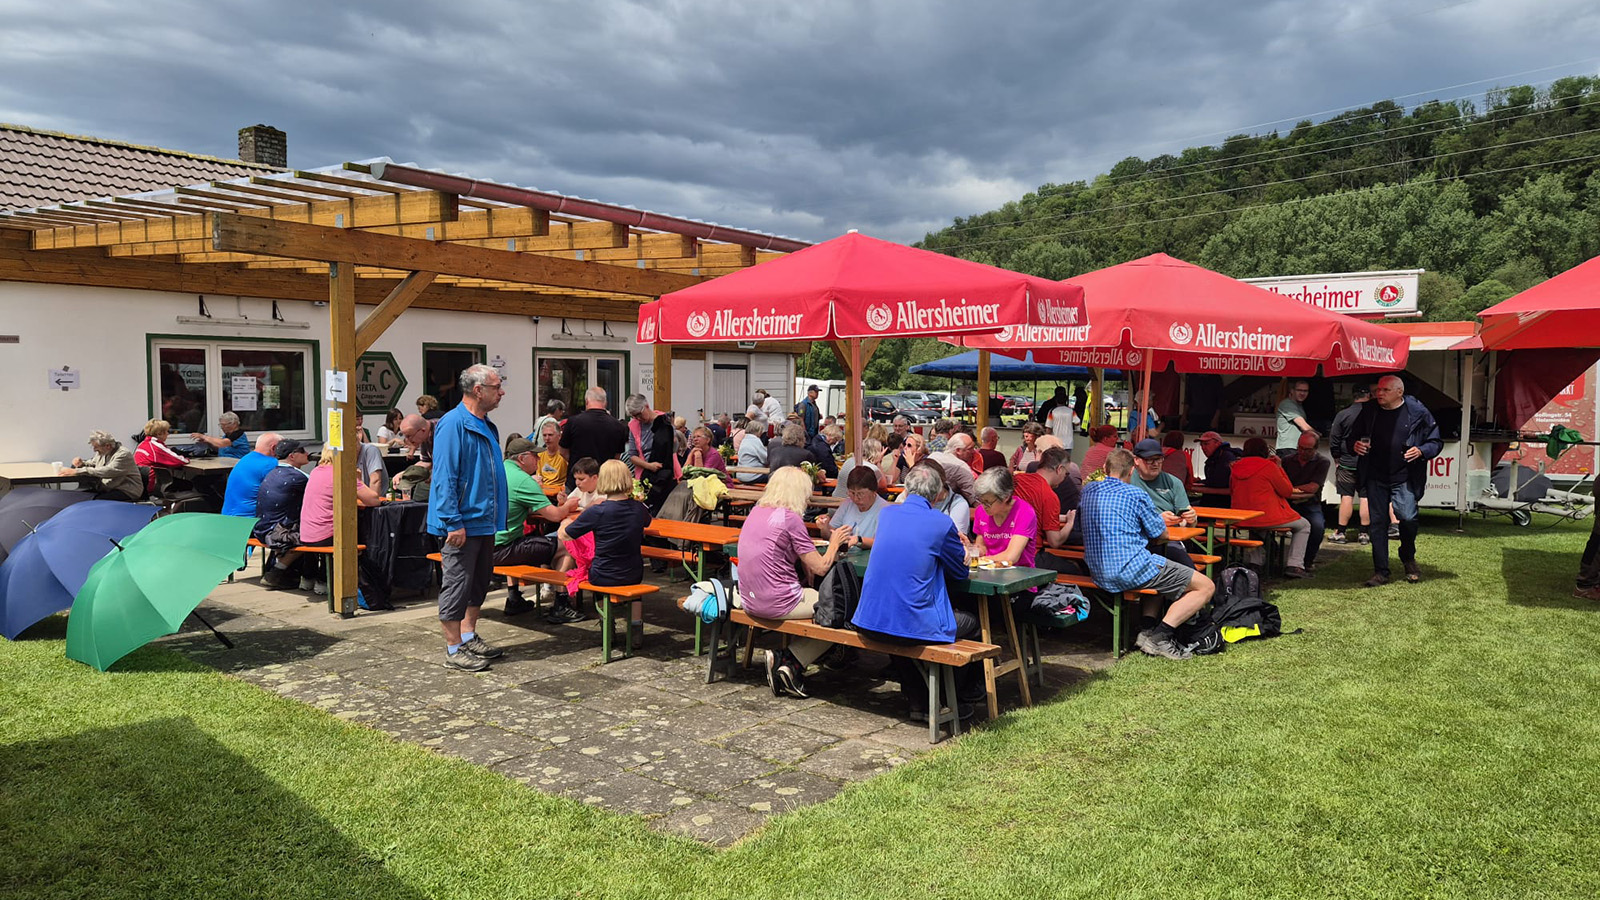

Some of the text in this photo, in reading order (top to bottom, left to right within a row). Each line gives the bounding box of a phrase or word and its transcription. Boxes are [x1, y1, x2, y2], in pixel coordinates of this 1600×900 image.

[712, 307, 803, 337] Allersheimer
[897, 298, 1000, 330] Allersheimer
[1046, 298, 1079, 324] Allersheimer
[1195, 323, 1294, 352] Allersheimer
[1358, 336, 1397, 363] Allersheimer
[361, 362, 392, 390] F C
